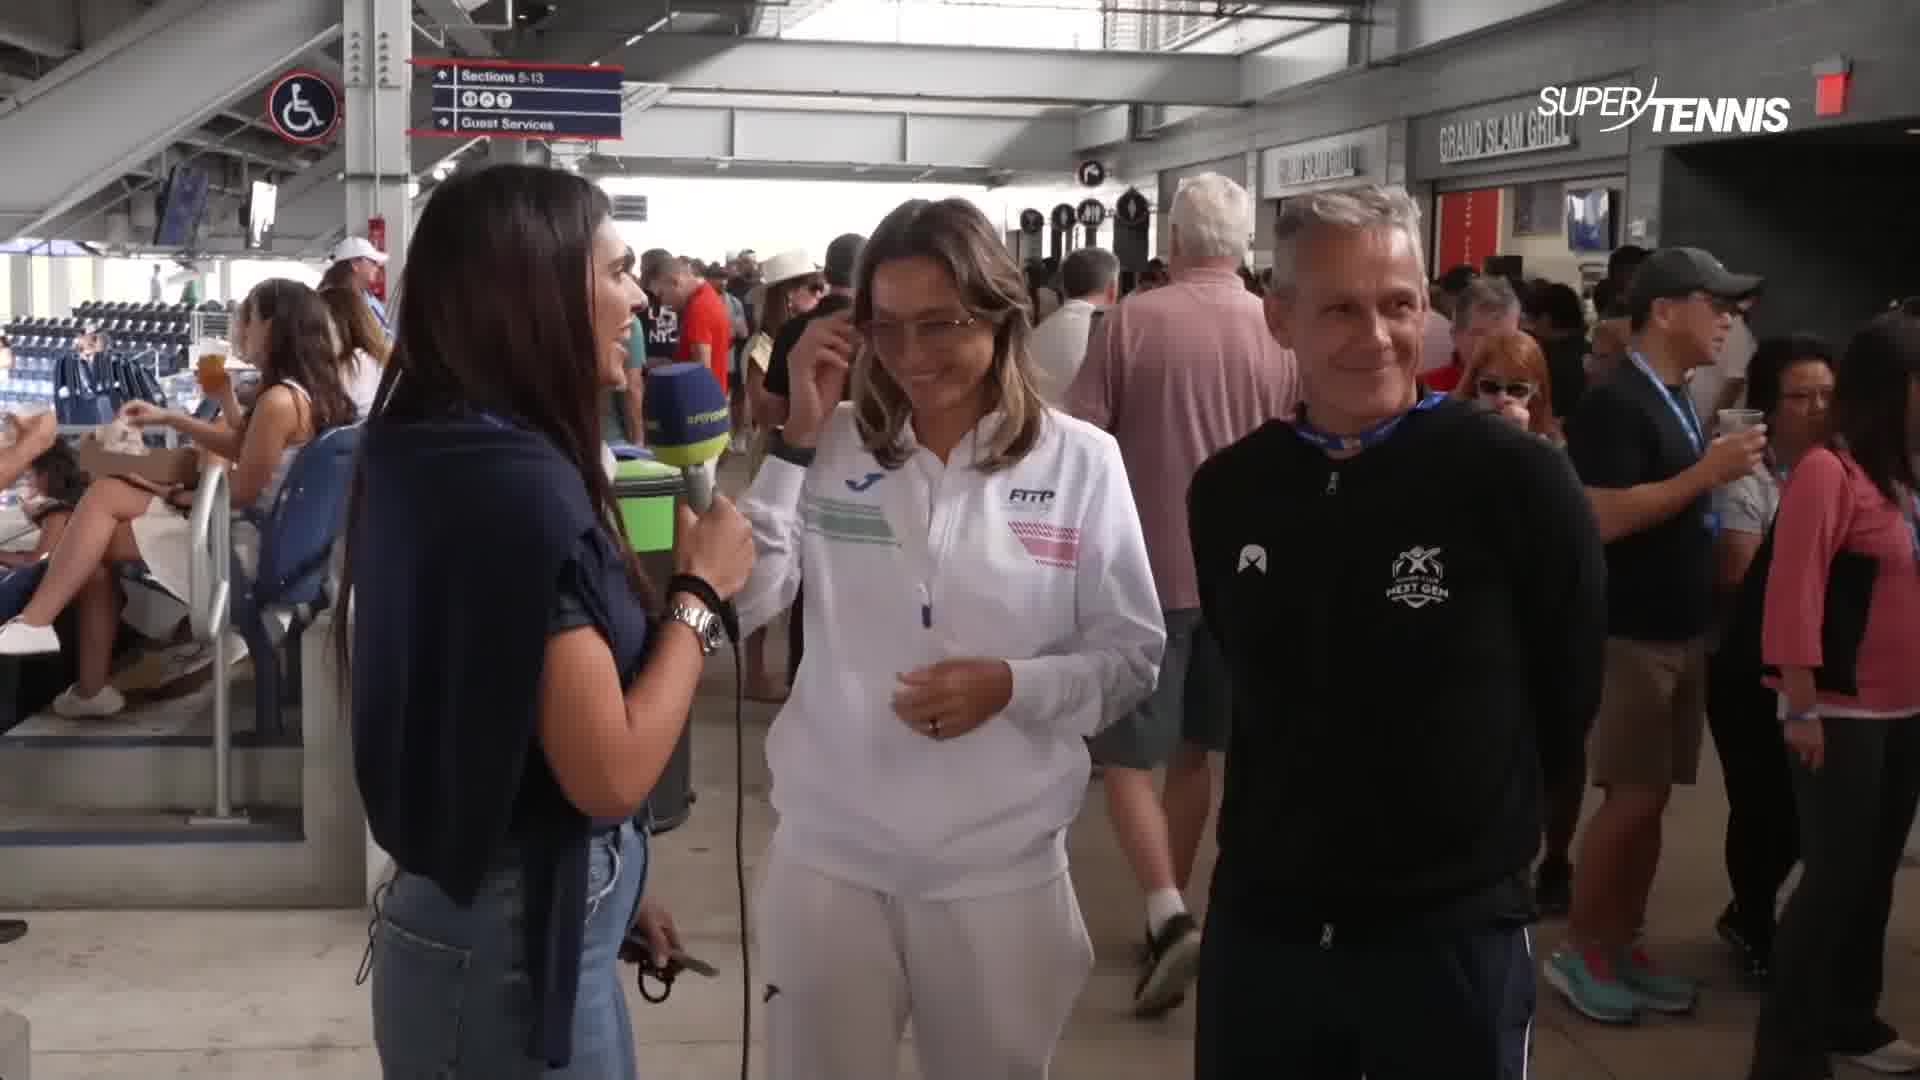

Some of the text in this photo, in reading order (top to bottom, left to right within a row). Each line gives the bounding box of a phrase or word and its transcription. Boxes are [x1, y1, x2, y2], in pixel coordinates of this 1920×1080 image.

[461, 69, 544, 84] Sections 5-13
[461, 116, 555, 131] Guest Services
[1439, 109, 1571, 161] GRAND SLAM GRILL
[648, 329, 678, 344] NYC
[1385, 583, 1449, 598] NEXT GEN
